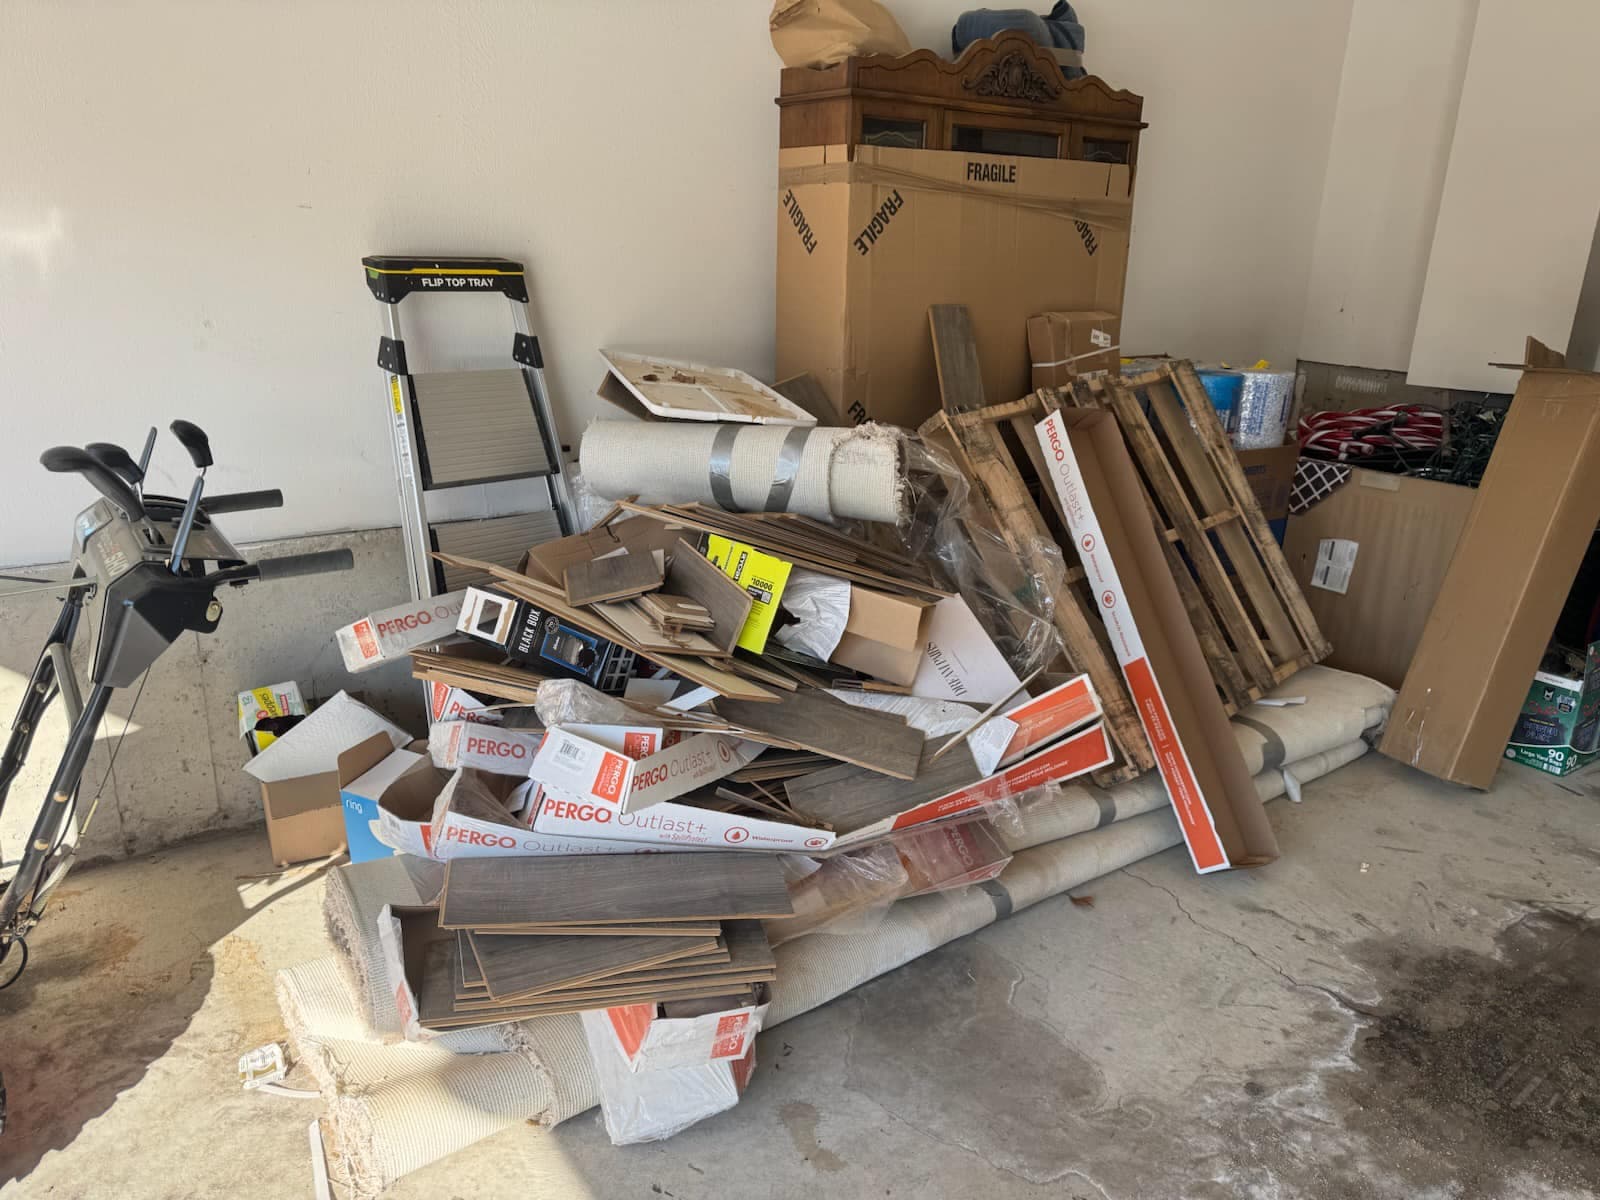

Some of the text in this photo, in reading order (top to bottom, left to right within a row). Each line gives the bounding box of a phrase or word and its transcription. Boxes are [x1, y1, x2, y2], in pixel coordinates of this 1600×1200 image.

[967, 162, 1017, 183] FRAGILE
[783, 189, 818, 256] FRAGILE
[853, 189, 904, 256] FRAGILE
[421, 278, 494, 287] FLIP TOP TRAY
[1045, 418, 1065, 462] PERGO
[377, 610, 432, 638] PERGO
[526, 608, 541, 627] BOX
[518, 627, 536, 654] BLACK
[466, 737, 526, 759] PERGO
[1548, 748, 1564, 762] 90
[1566, 754, 1578, 769] 90
[608, 757, 624, 796] PERGO
[632, 763, 668, 793] PERGO
[670, 750, 713, 777] Outlast+
[346, 799, 363, 815] ring
[544, 798, 707, 834] PERGO Outlast+
[446, 826, 517, 849] PERGO
[950, 824, 974, 867] PERGO
